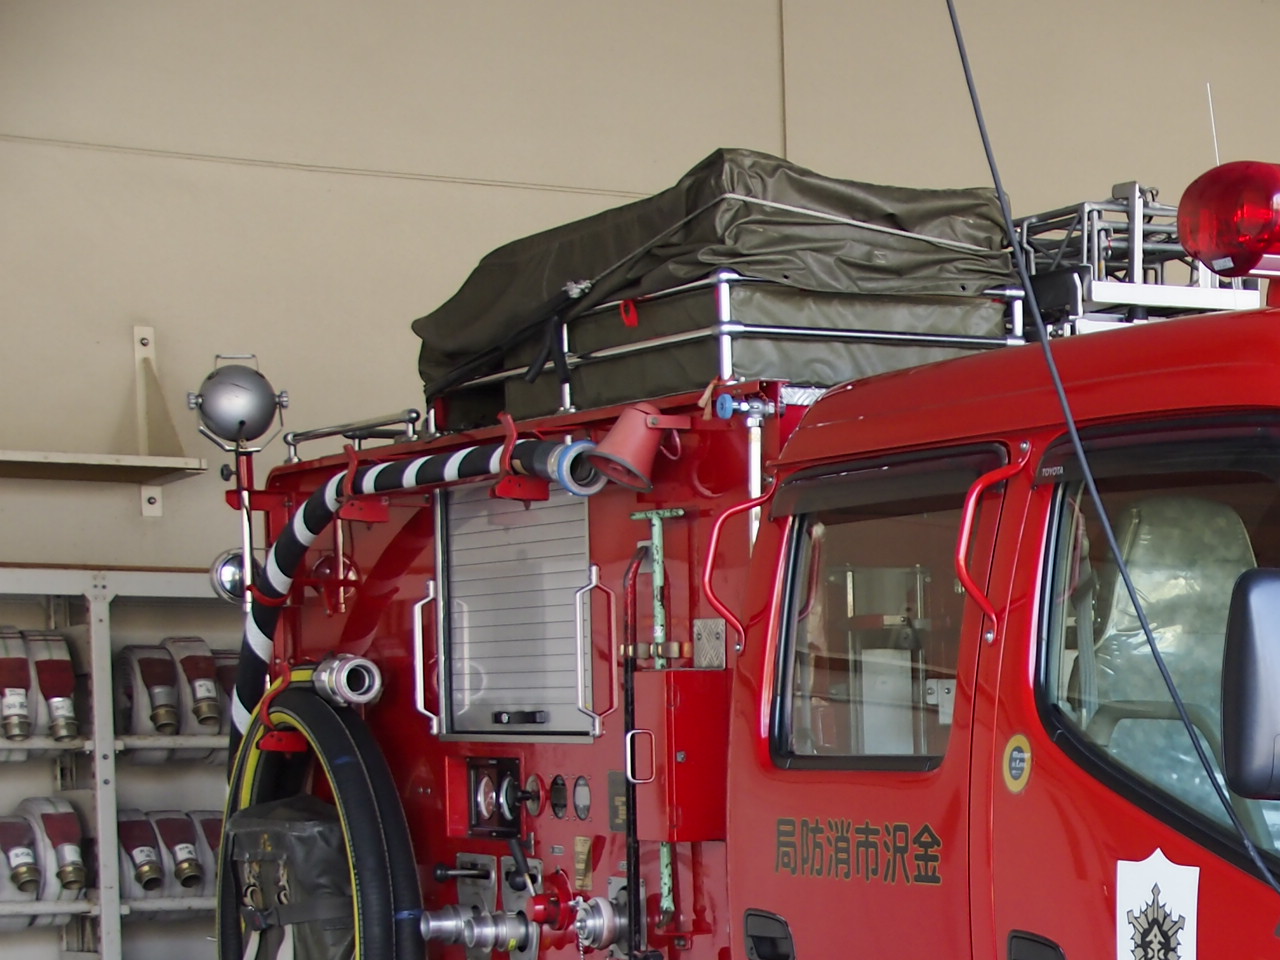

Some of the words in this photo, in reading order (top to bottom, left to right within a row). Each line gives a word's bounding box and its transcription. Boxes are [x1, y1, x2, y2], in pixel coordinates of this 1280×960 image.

[1041, 466, 1064, 477] TOYOTA
[775, 817, 943, 887] 局防消市沢金
